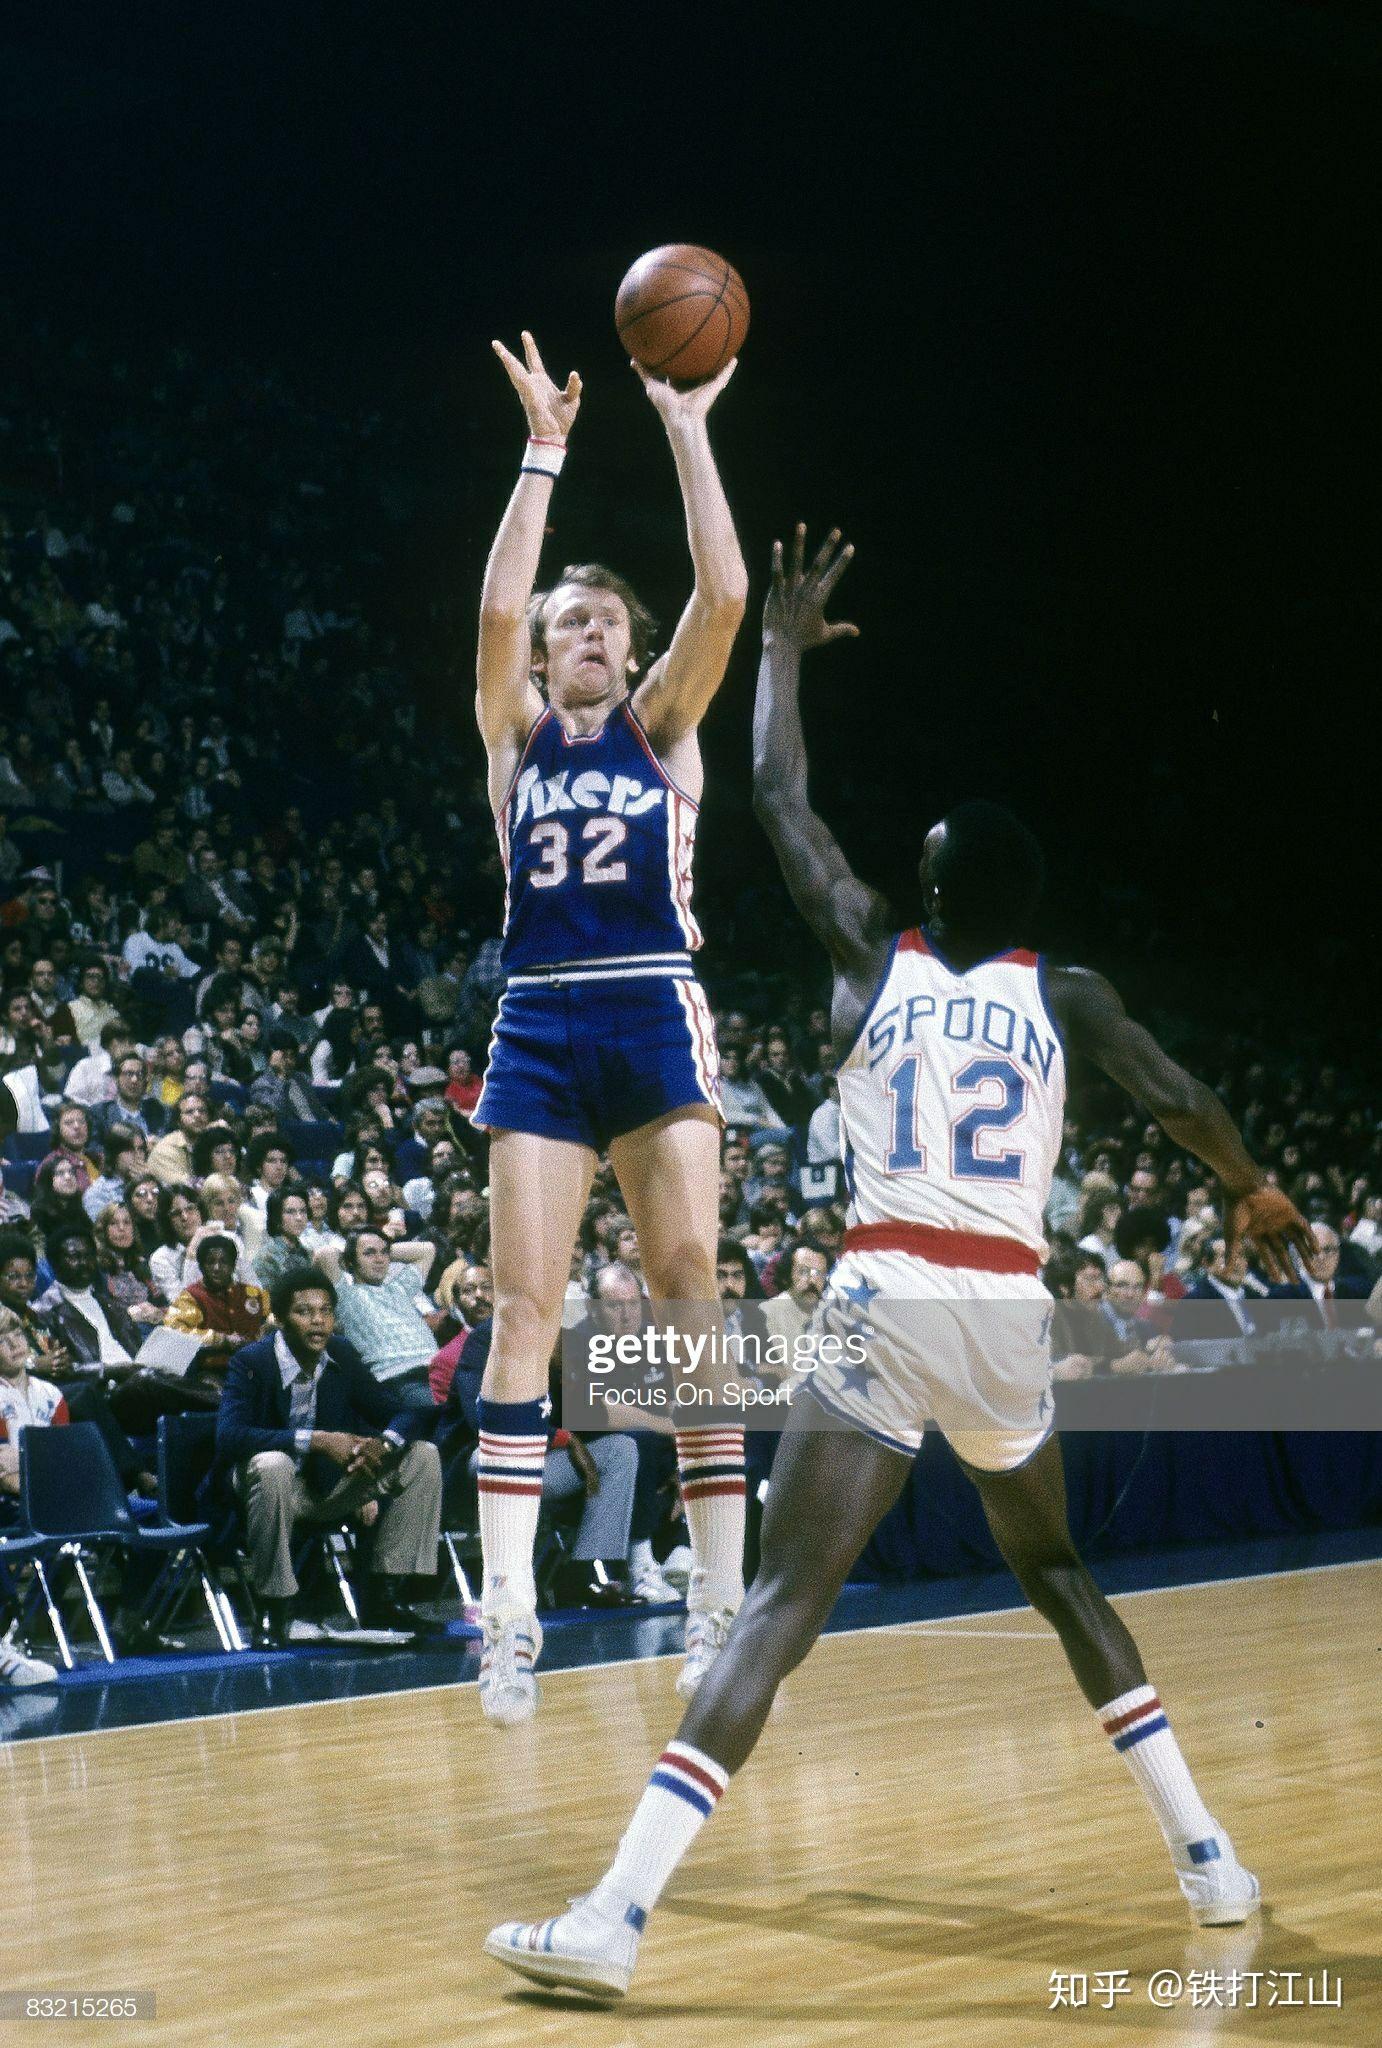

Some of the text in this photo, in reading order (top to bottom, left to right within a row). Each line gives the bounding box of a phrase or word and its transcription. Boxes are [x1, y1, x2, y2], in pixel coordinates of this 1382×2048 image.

[529, 816, 627, 889] 32
[867, 995, 1056, 1088] SPOON
[884, 1053, 1030, 1186] 12
